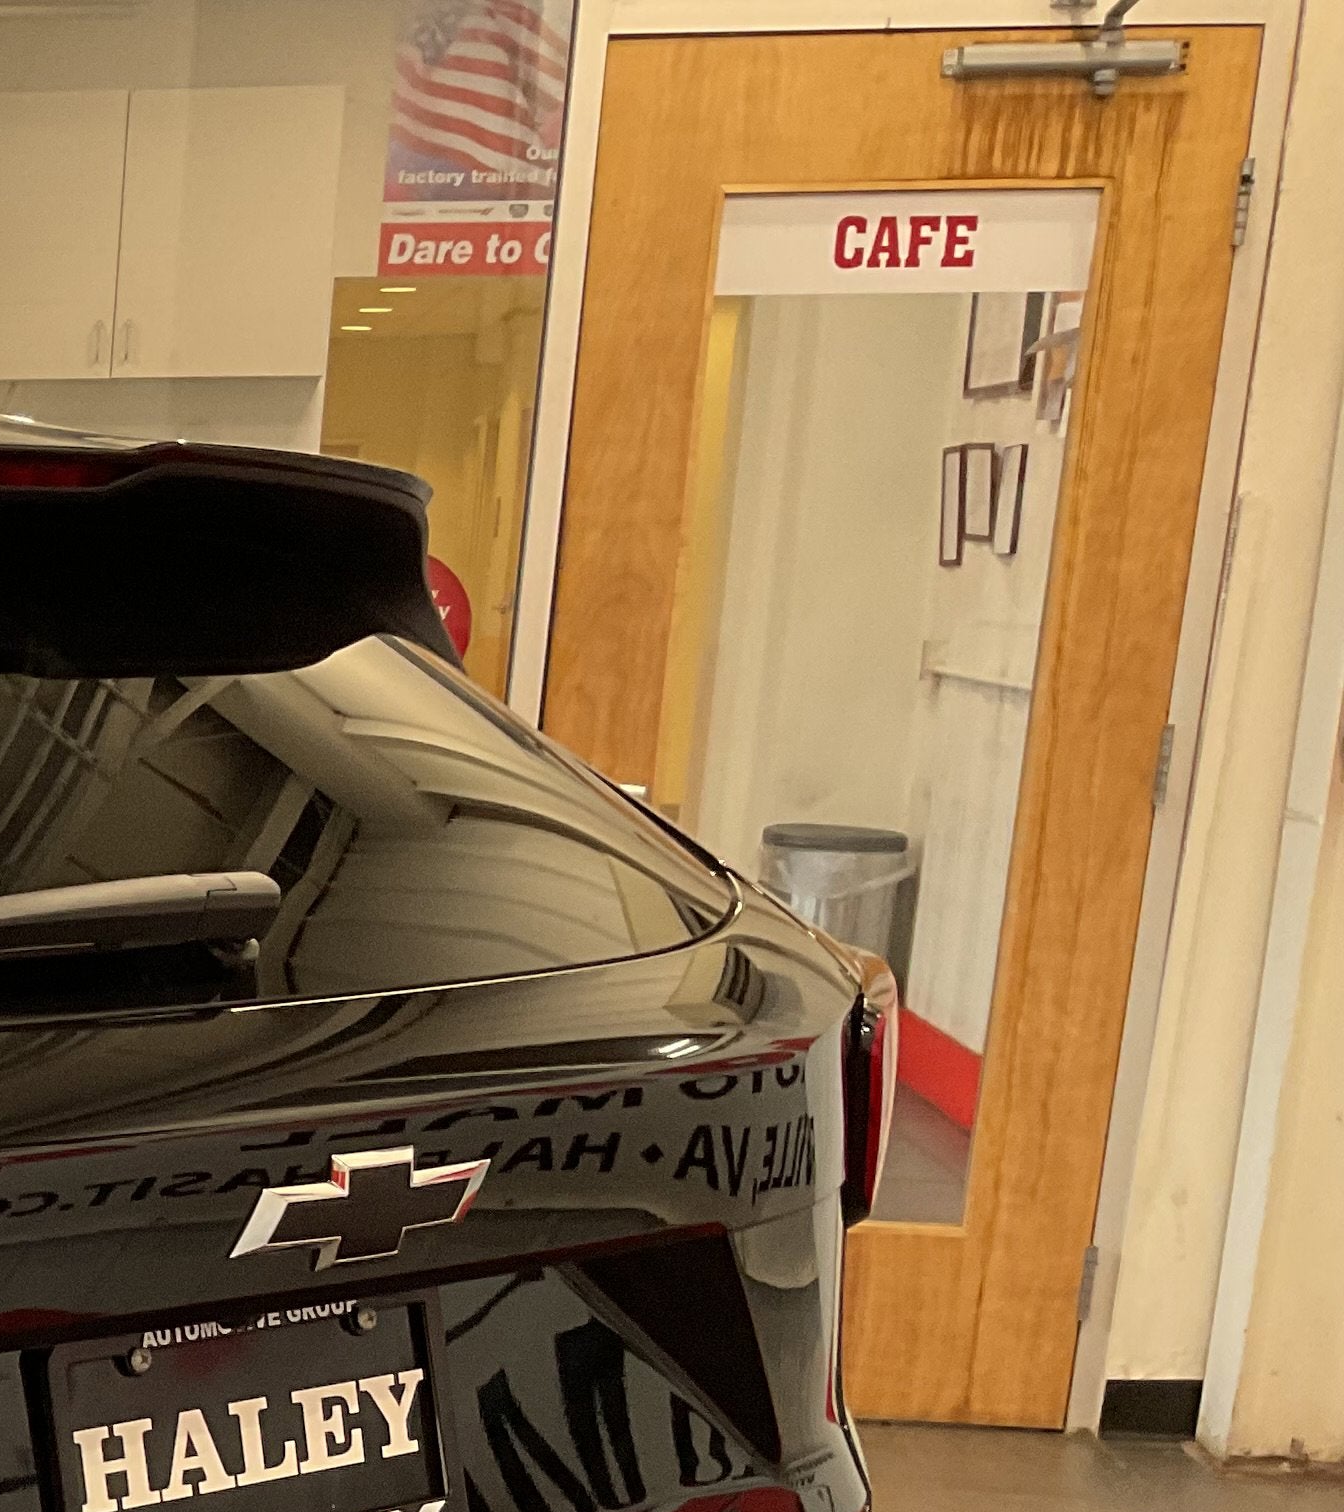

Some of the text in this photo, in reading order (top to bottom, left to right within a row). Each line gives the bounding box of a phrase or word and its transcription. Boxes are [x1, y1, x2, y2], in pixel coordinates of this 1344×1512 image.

[398, 170, 465, 187] factory
[471, 168, 540, 184] trained
[387, 234, 474, 265] Dare
[485, 233, 523, 264] to
[834, 215, 979, 269] CAFE
